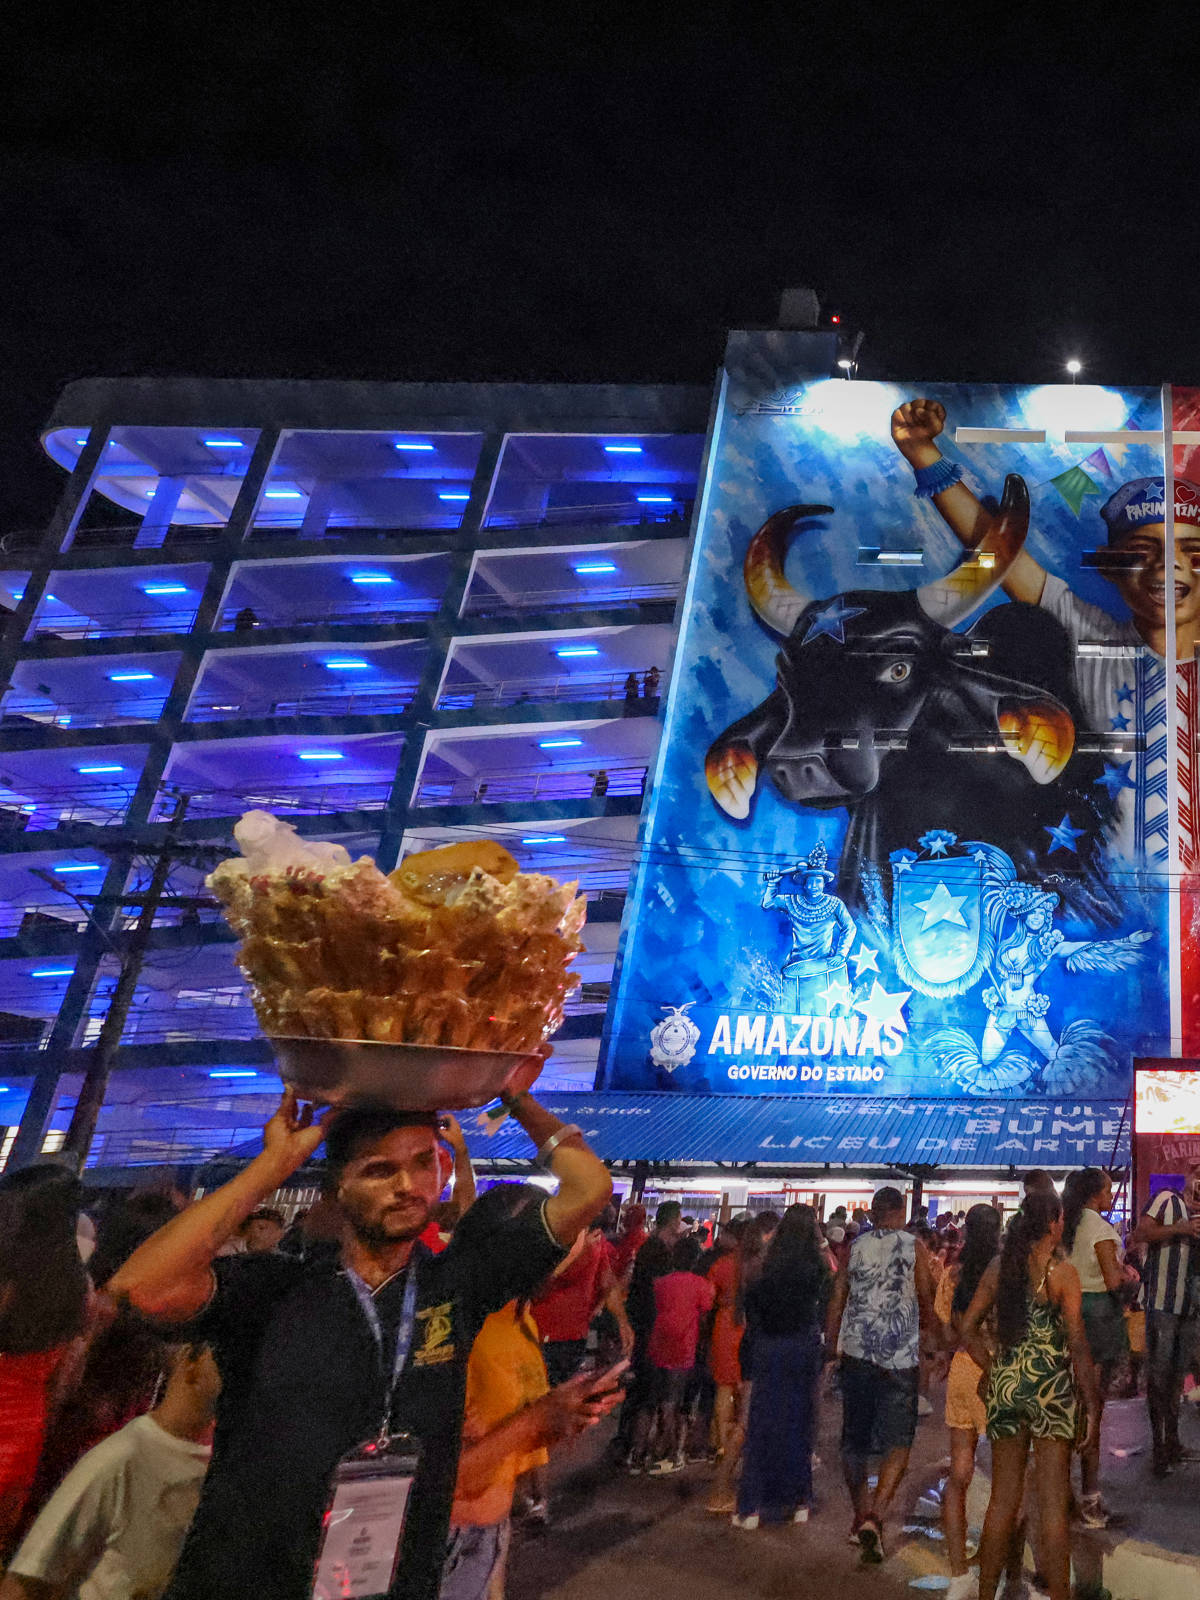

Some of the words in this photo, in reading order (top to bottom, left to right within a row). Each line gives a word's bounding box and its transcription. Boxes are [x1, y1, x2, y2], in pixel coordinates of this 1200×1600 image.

[707, 1015, 905, 1056] AMAZONAS
[727, 1065, 797, 1081] GOVERNO
[800, 1066, 823, 1081] DO
[826, 1066, 884, 1082] ESTADO
[825, 1104, 1005, 1116] CENTRO
[1020, 1105, 1132, 1118] CULT
[758, 1135, 900, 1150] LICEU
[915, 1137, 977, 1152] DE
